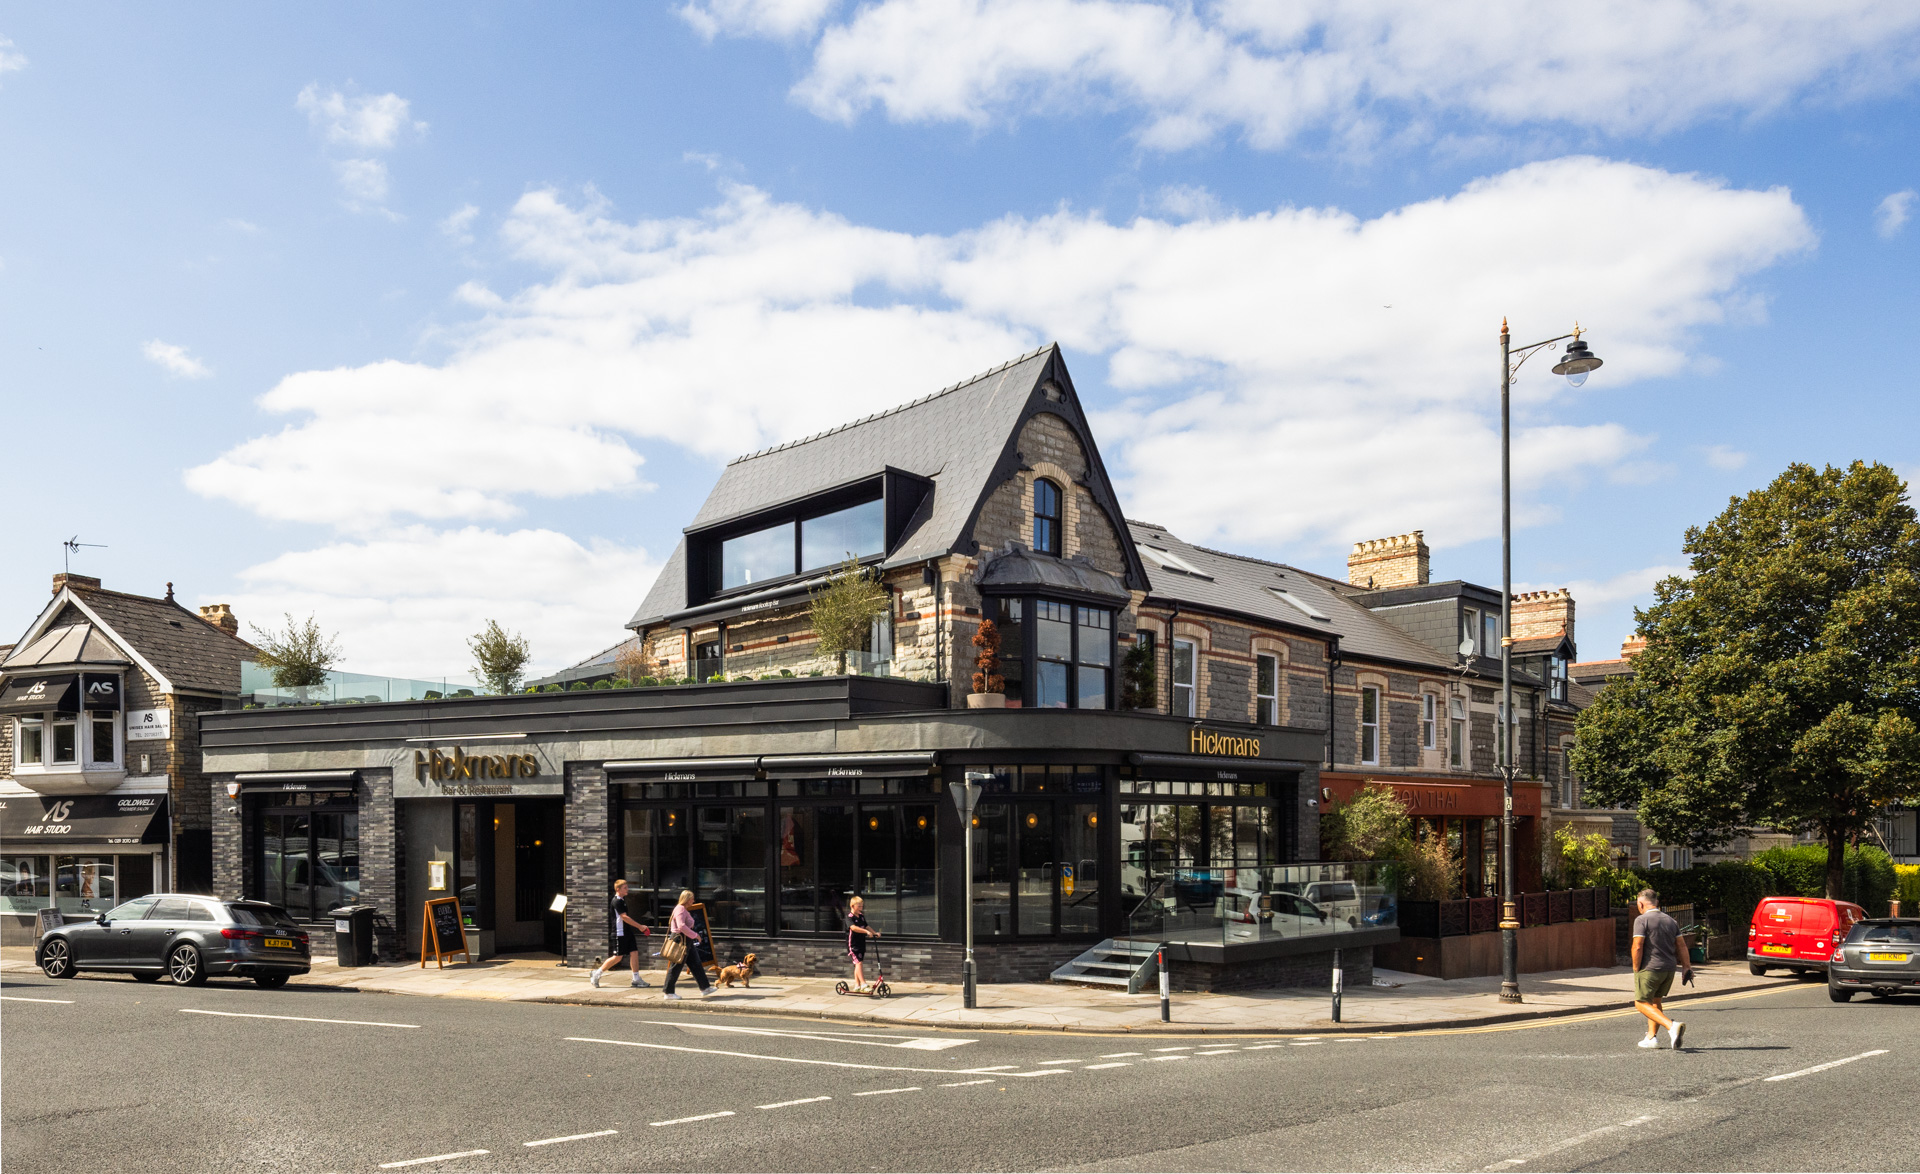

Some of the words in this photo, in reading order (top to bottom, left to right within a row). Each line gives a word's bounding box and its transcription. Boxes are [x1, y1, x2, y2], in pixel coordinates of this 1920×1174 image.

[27, 680, 48, 694] AS
[88, 682, 114, 694] AS
[143, 713, 154, 723] AS
[1191, 729, 1260, 757] Hickmans
[415, 745, 536, 781] Hickmans
[664, 772, 696, 781] Hickmans
[828, 767, 863, 776] Hickmans
[1217, 771, 1238, 780] Hickmans
[283, 782, 308, 791] Hickmans
[442, 784, 456, 796] Bar
[457, 784, 467, 796] &
[467, 784, 513, 796] Restaurant
[117, 798, 155, 806] GOLDWELL
[1428, 789, 1458, 810] THAI
[42, 800, 75, 822] AS
[24, 825, 44, 834] HAIR
[44, 825, 72, 834] STUDIO
